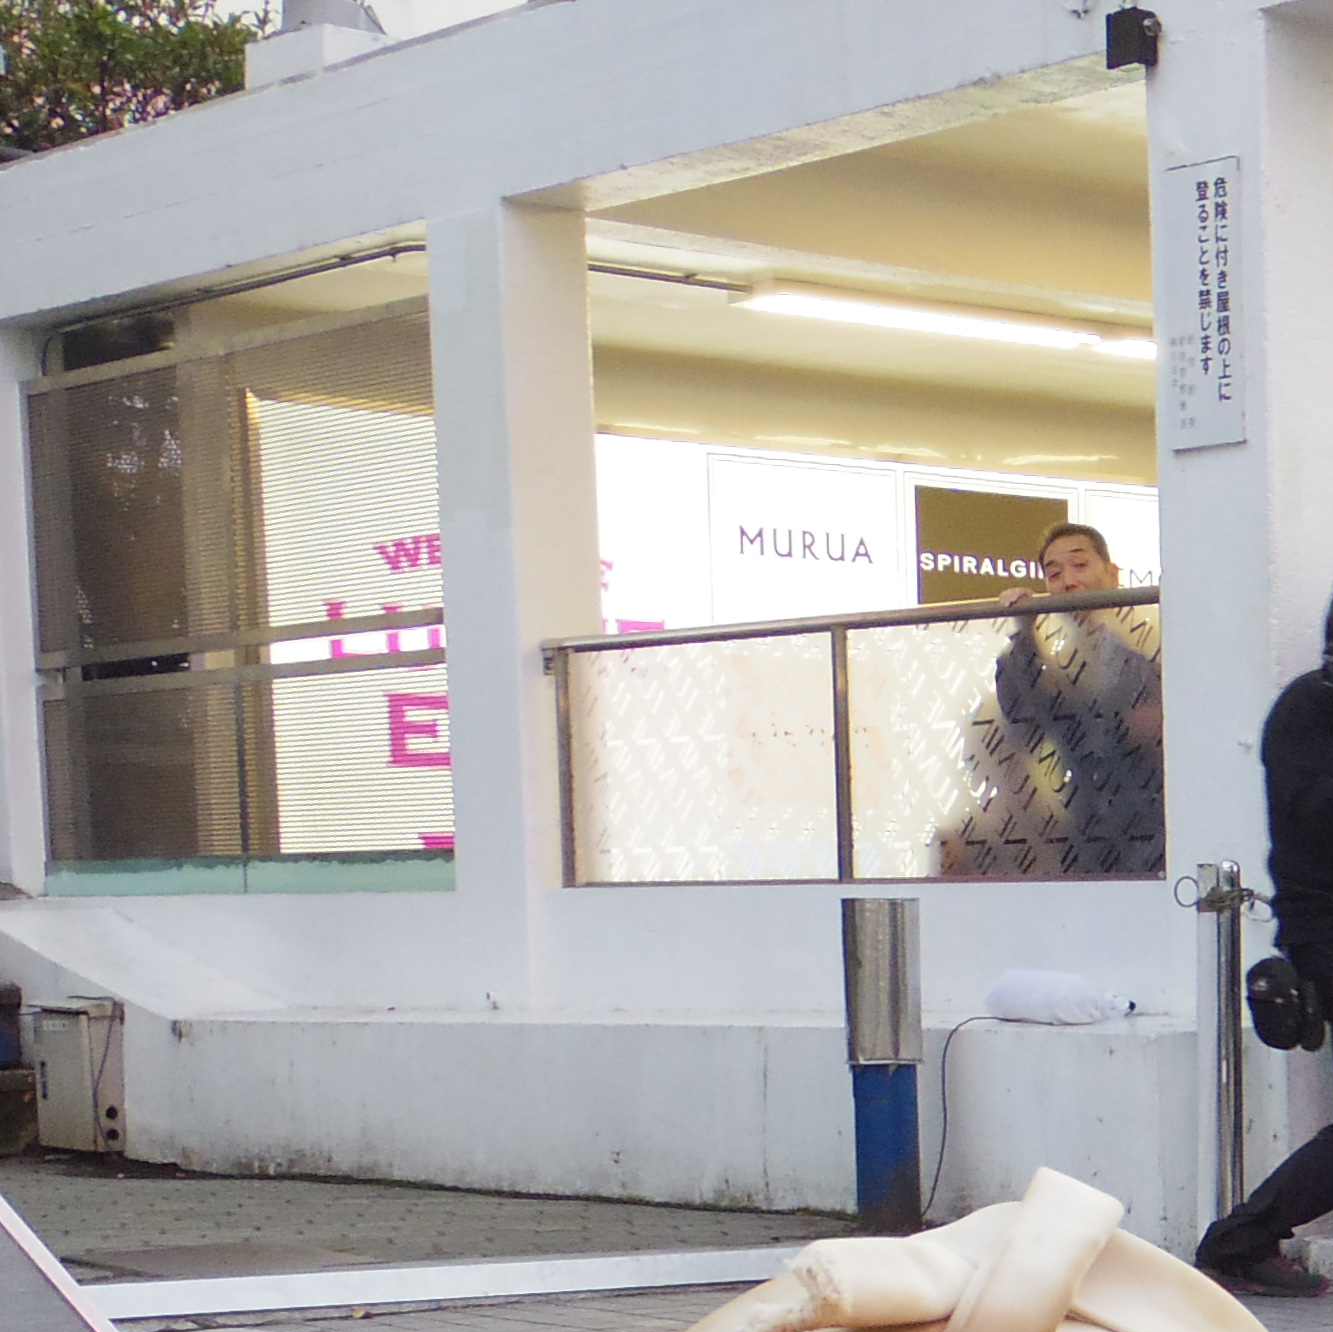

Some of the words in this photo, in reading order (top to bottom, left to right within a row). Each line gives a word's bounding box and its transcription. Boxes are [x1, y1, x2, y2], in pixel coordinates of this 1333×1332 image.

[1195, 180, 1213, 376] 登ることを禁じます
[1213, 176, 1232, 402] 危険に付き屋根の上に
[739, 525, 873, 564] MURUA
